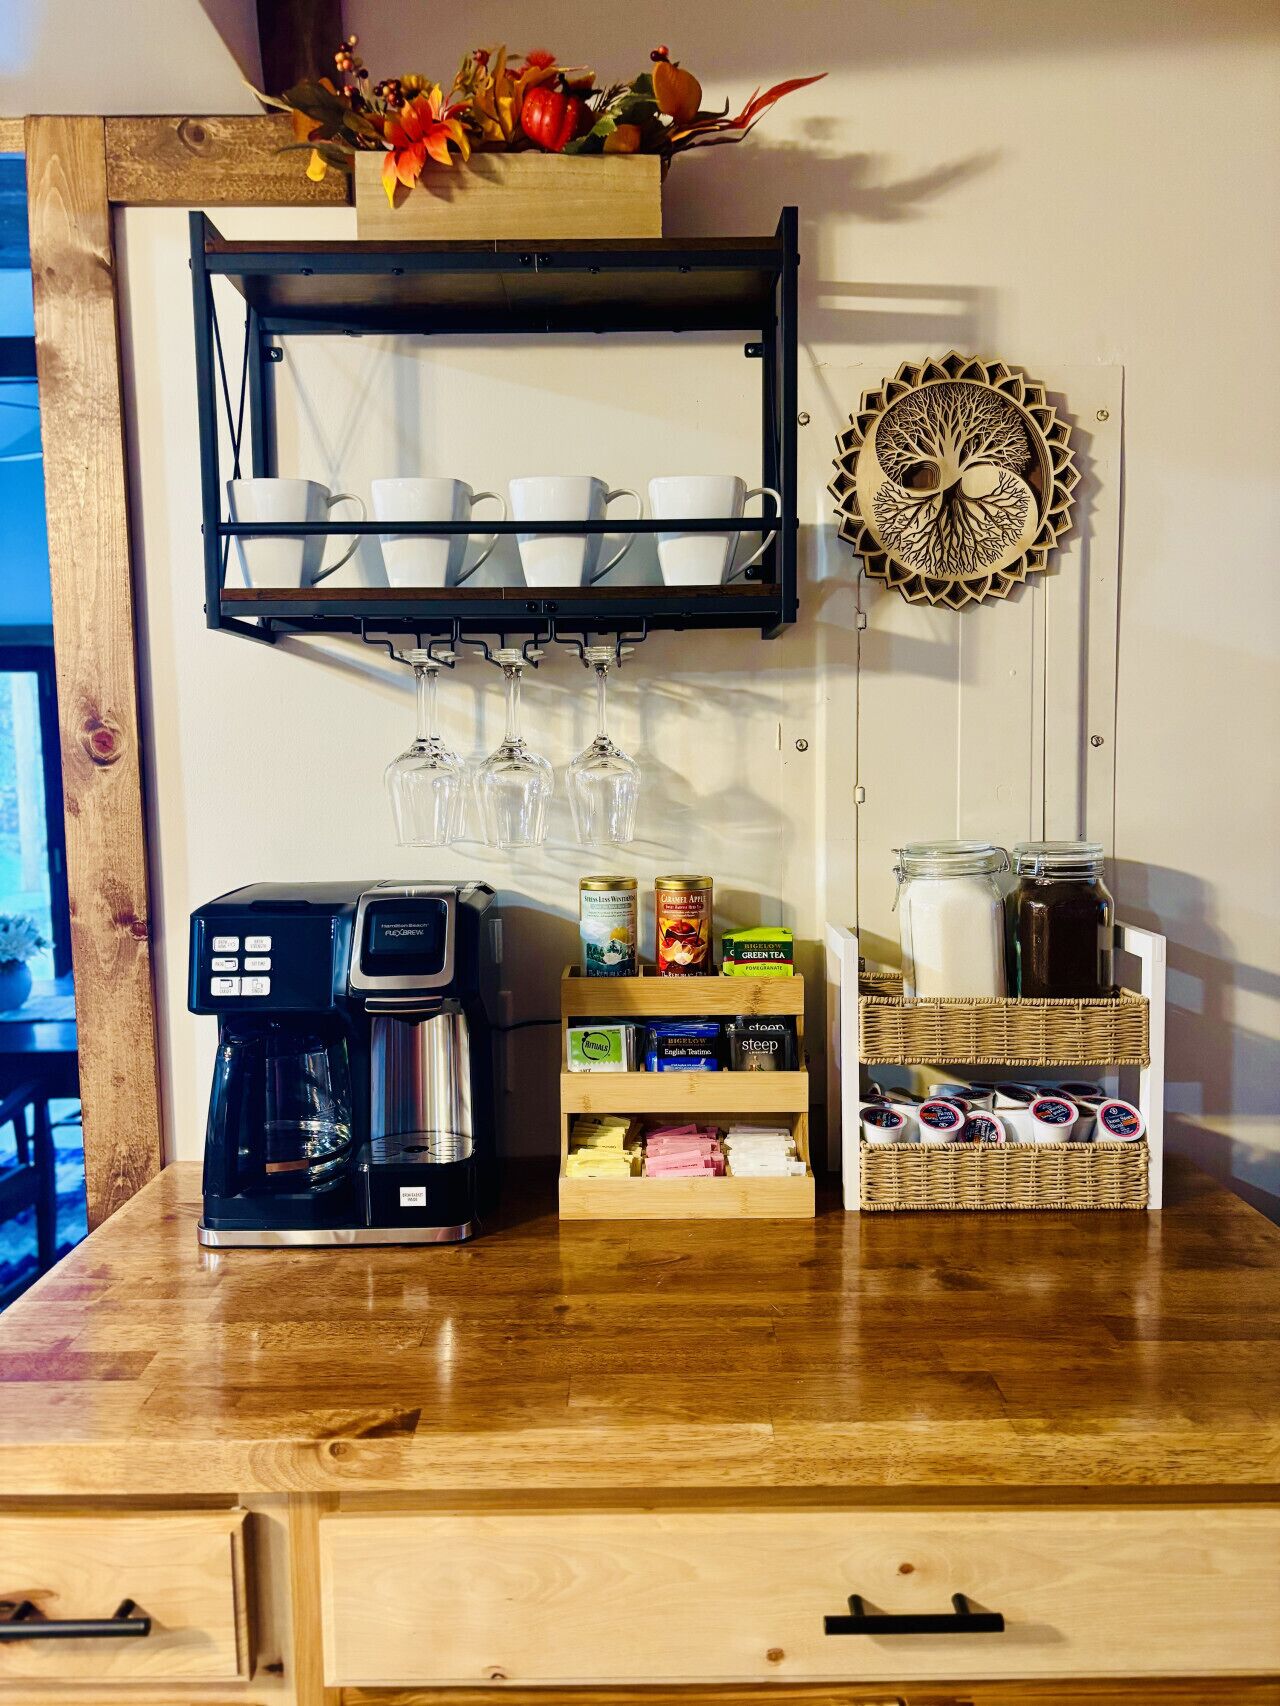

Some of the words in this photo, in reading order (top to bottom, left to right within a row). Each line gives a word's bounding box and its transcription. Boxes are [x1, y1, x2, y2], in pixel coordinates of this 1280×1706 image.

[661, 893, 688, 903] CARAMEL
[689, 894, 706, 903] APPLE
[741, 951, 769, 959] GREEN
[769, 951, 786, 959] TEA
[585, 1040, 609, 1052] RITUALS
[742, 1038, 778, 1054] steep
[664, 1048, 687, 1056] English
